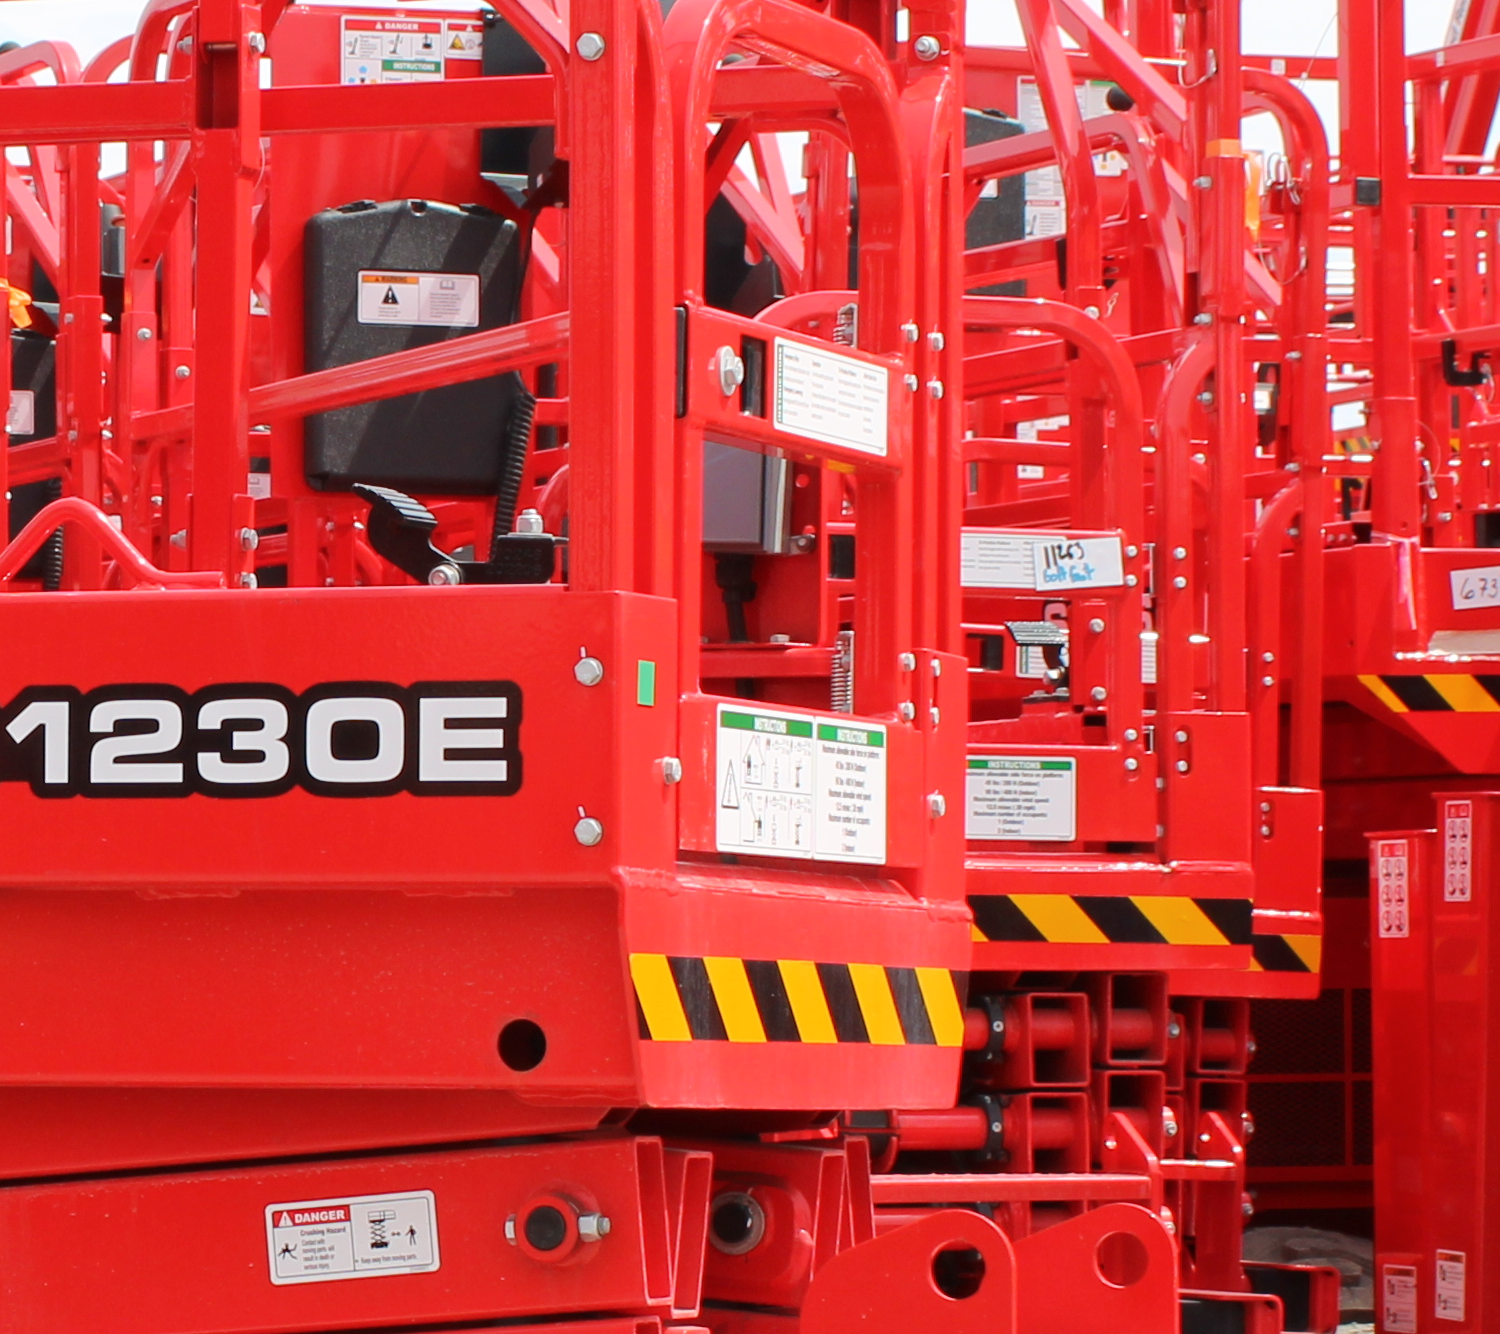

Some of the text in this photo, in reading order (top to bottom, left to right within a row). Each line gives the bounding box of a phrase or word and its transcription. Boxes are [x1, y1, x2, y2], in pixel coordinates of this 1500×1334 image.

[385, 22, 418, 30] DANGER
[1461, 578, 1498, 600] 673
[295, 1209, 345, 1223] DANGER
[301, 1226, 346, 1237] Crushing Hazard
